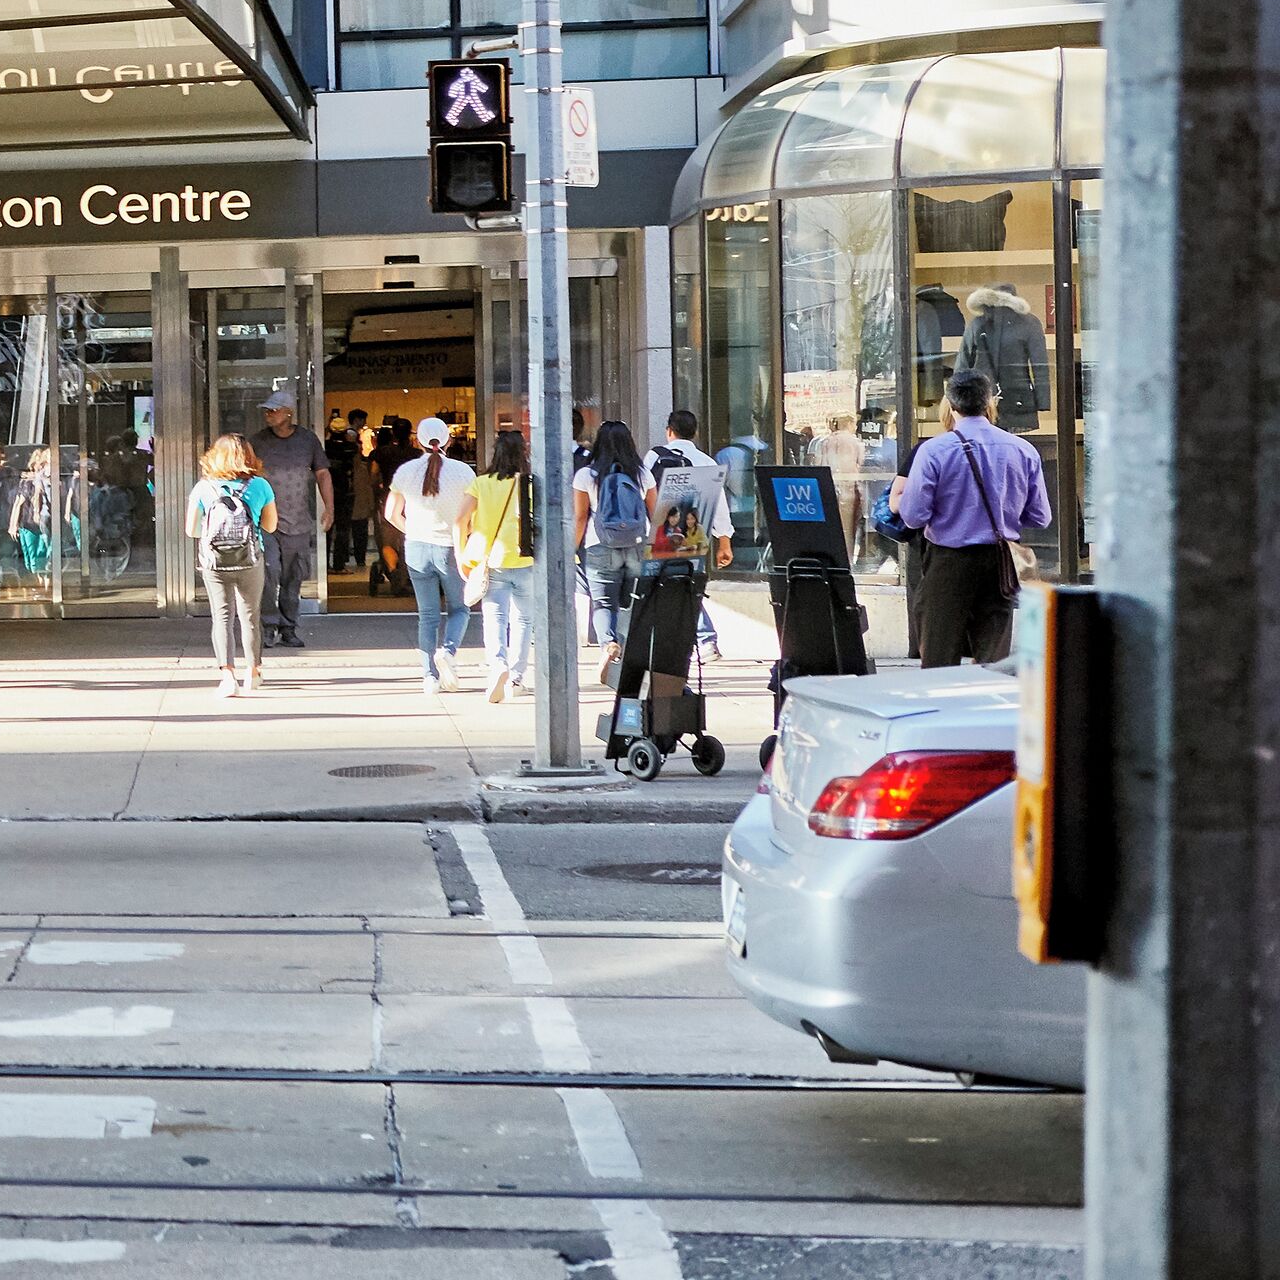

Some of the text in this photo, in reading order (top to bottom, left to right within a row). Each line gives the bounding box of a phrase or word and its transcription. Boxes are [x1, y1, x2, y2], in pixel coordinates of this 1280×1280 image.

[80, 184, 251, 226] Centre
[665, 472, 691, 484] FREE
[785, 485, 811, 501] JW
[785, 503, 817, 515] .ORG
